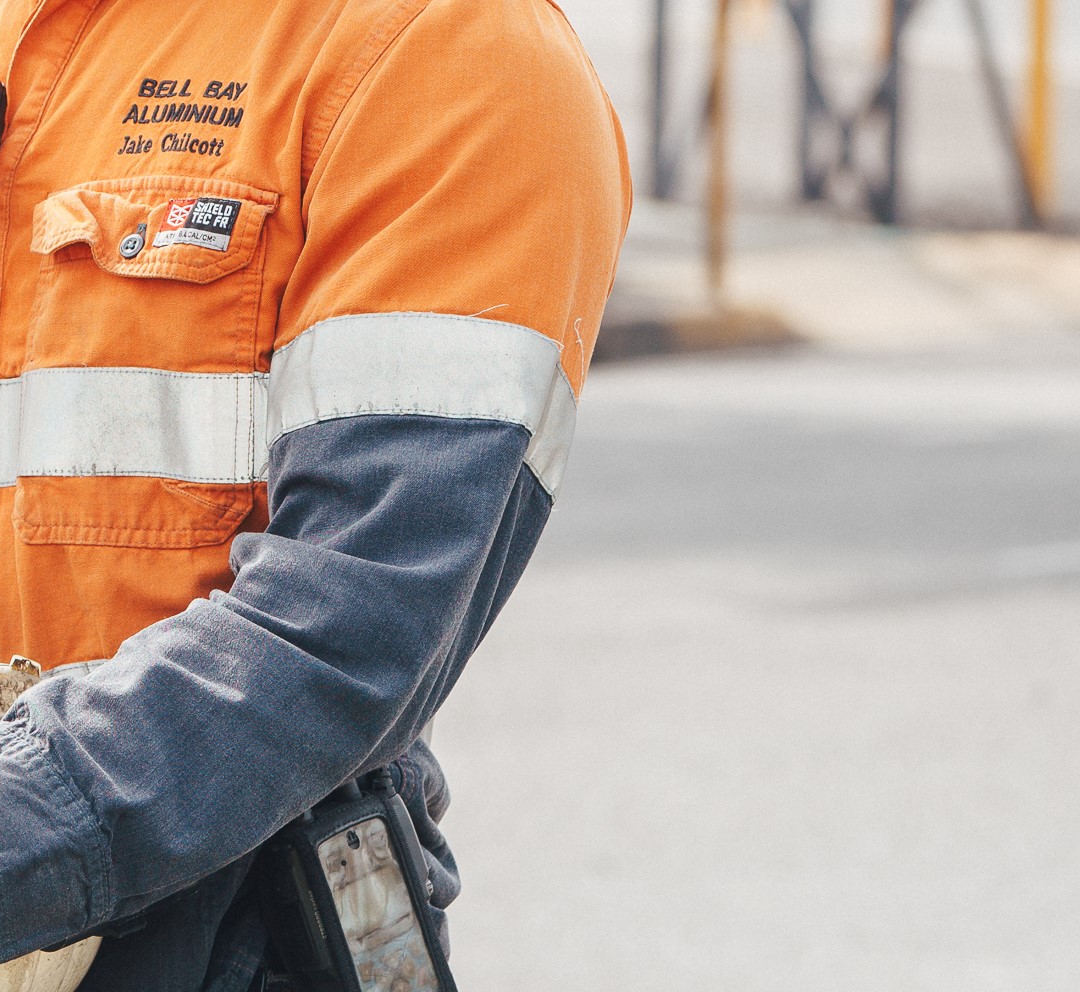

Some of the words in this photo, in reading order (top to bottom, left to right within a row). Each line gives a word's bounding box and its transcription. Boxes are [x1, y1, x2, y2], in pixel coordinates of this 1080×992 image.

[138, 78, 191, 98] BELL
[203, 80, 248, 101] BAY
[122, 103, 244, 128] ALUMINIUM
[118, 135, 153, 155] Jake
[161, 133, 224, 156] Chilcott
[191, 211, 213, 225] TEC
[213, 215, 230, 229] FR
[194, 201, 233, 217] SHIELD
